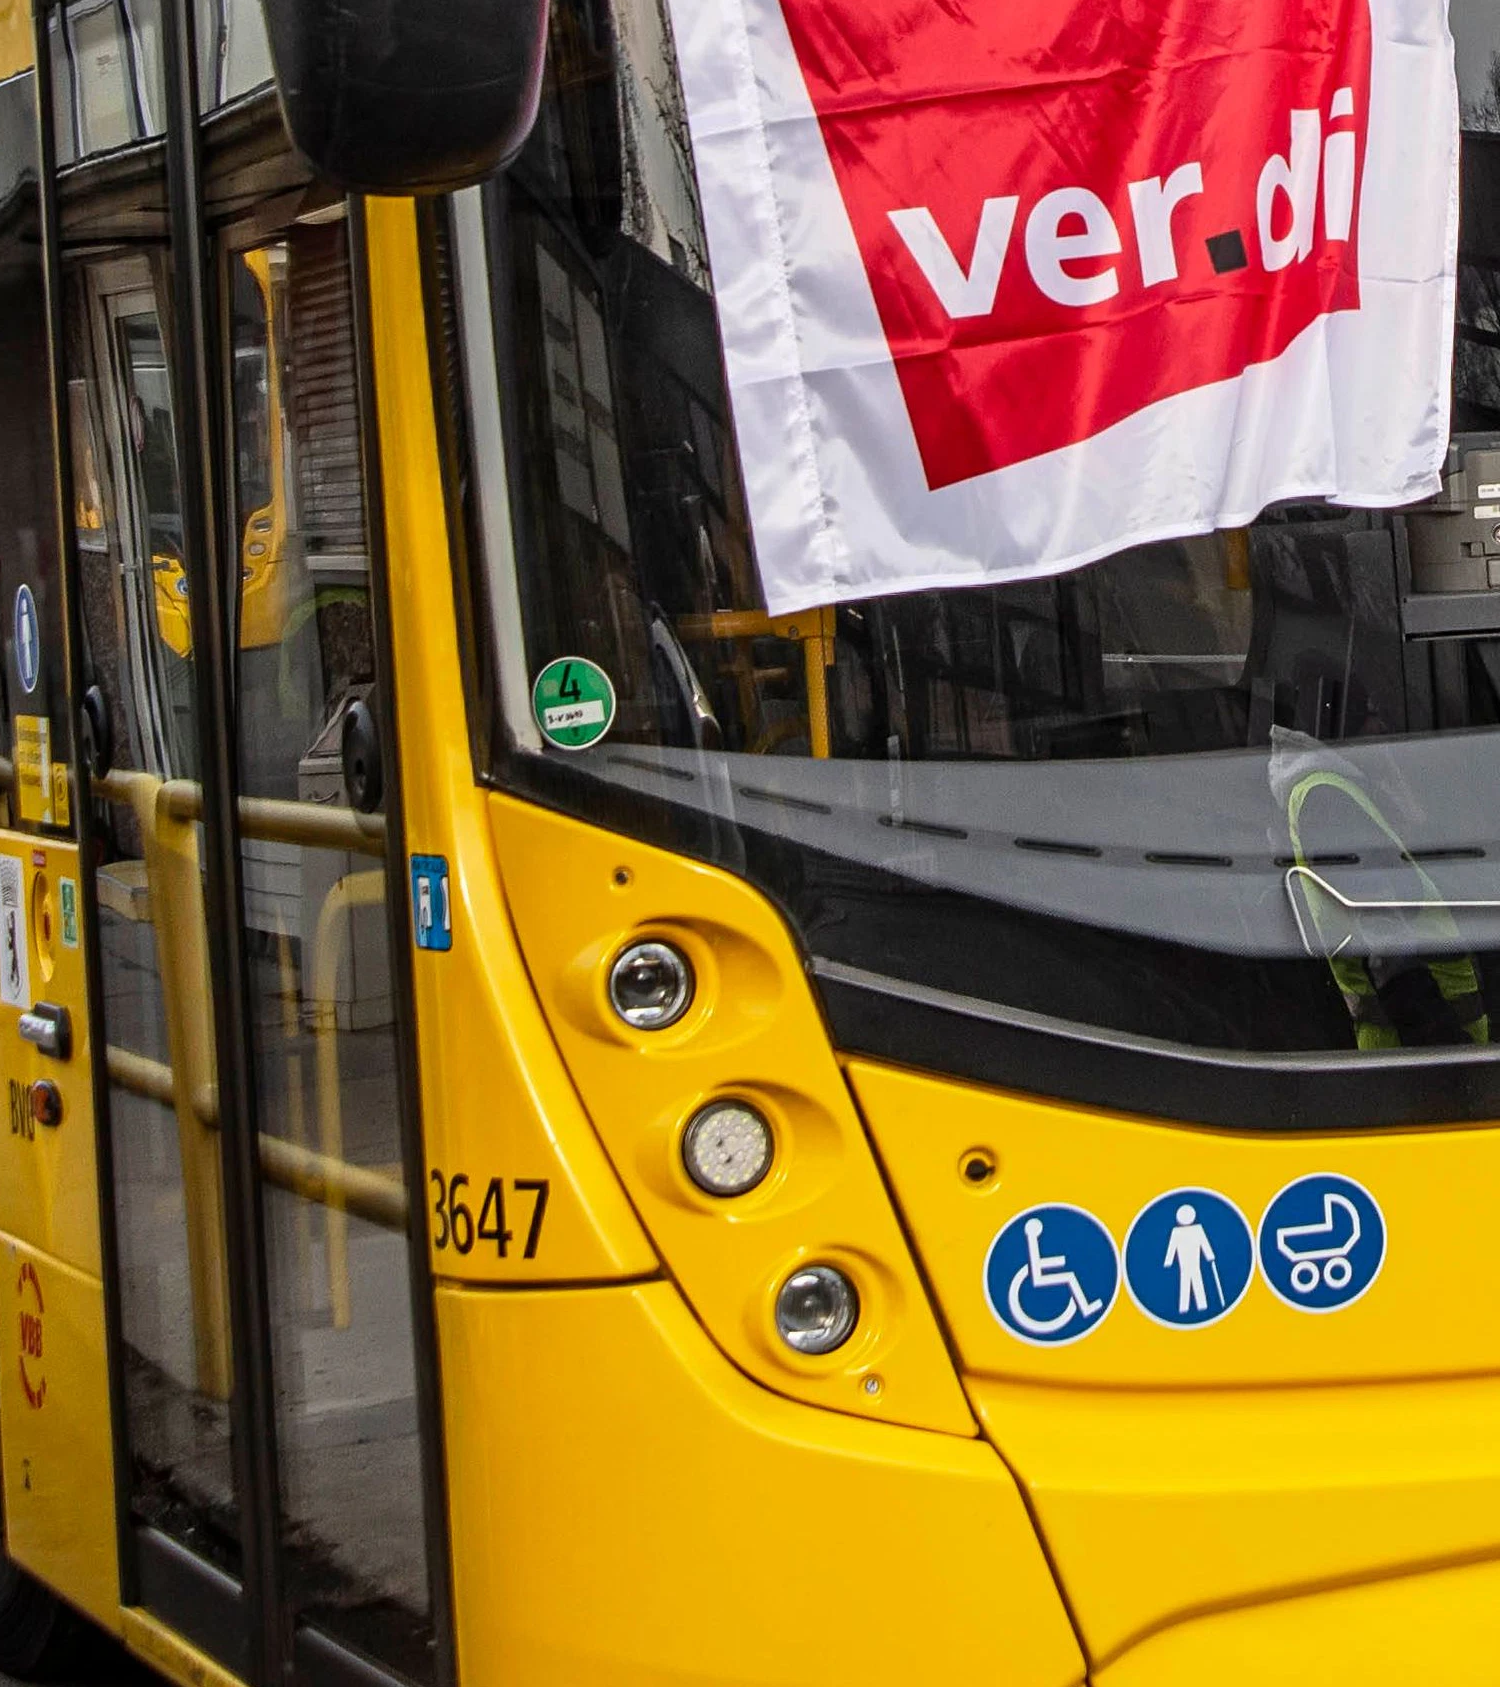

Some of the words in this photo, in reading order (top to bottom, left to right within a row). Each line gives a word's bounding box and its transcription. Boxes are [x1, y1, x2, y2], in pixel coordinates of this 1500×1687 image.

[887, 87, 1359, 318] ver.di
[559, 663, 581, 702] 4
[430, 1168, 550, 1261] 3647
